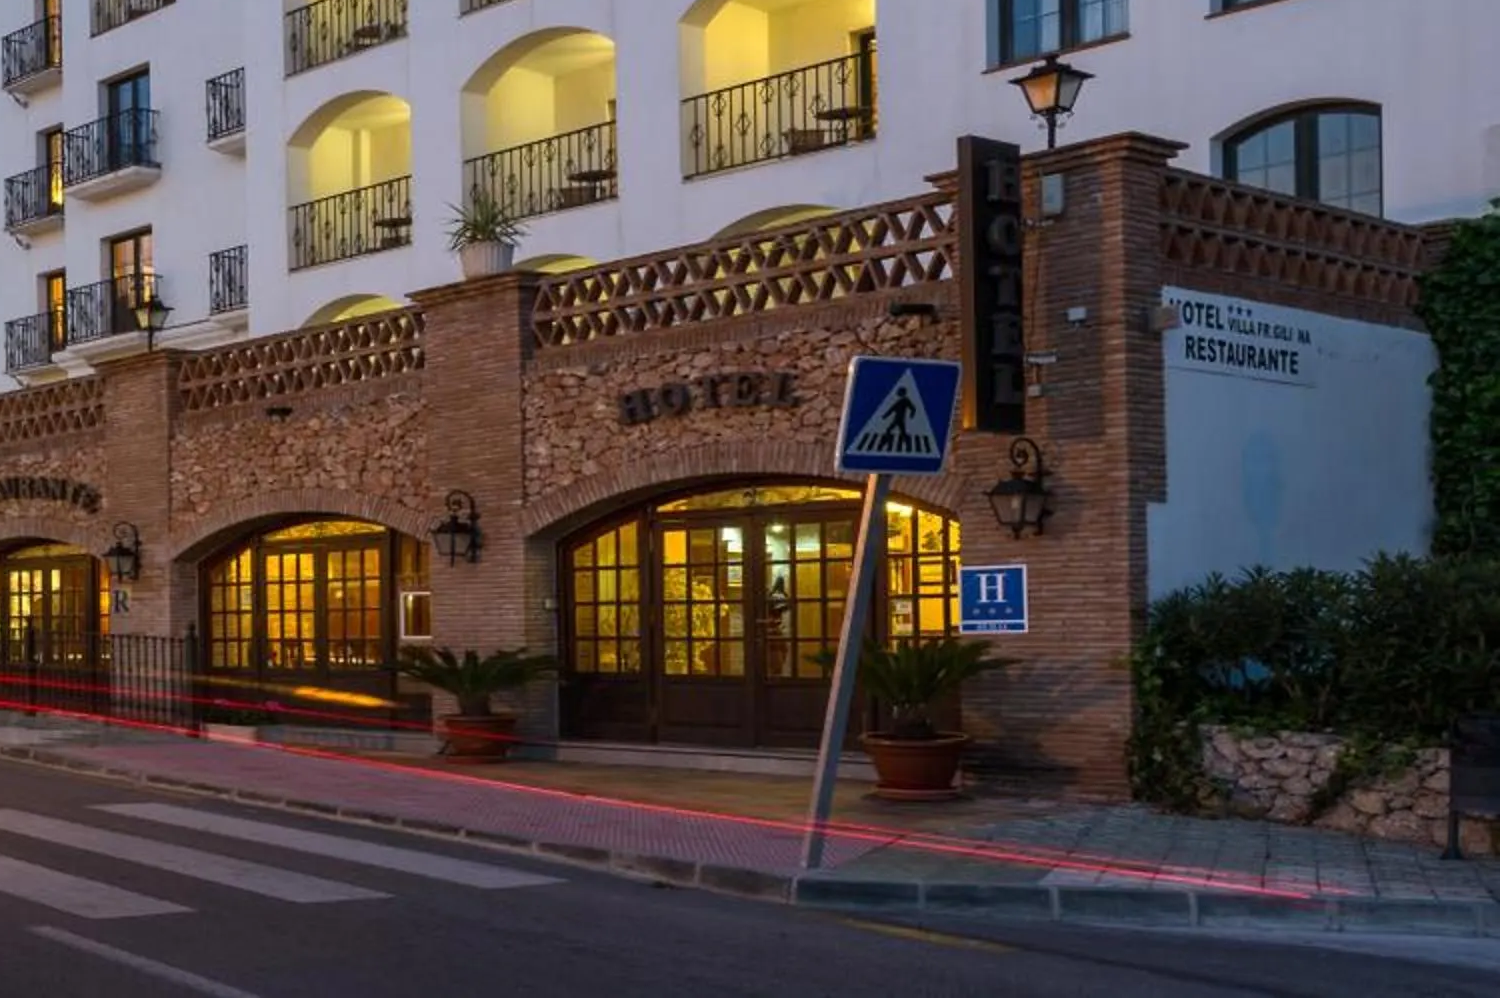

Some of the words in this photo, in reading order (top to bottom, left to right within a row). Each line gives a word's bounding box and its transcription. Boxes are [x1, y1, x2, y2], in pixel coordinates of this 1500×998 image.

[1169, 298, 1224, 330] OTEL
[1185, 335, 1299, 375] RESTAURANTE
[619, 372, 799, 426] HOTEL
[113, 589, 130, 614] R
[976, 573, 1008, 603] H
